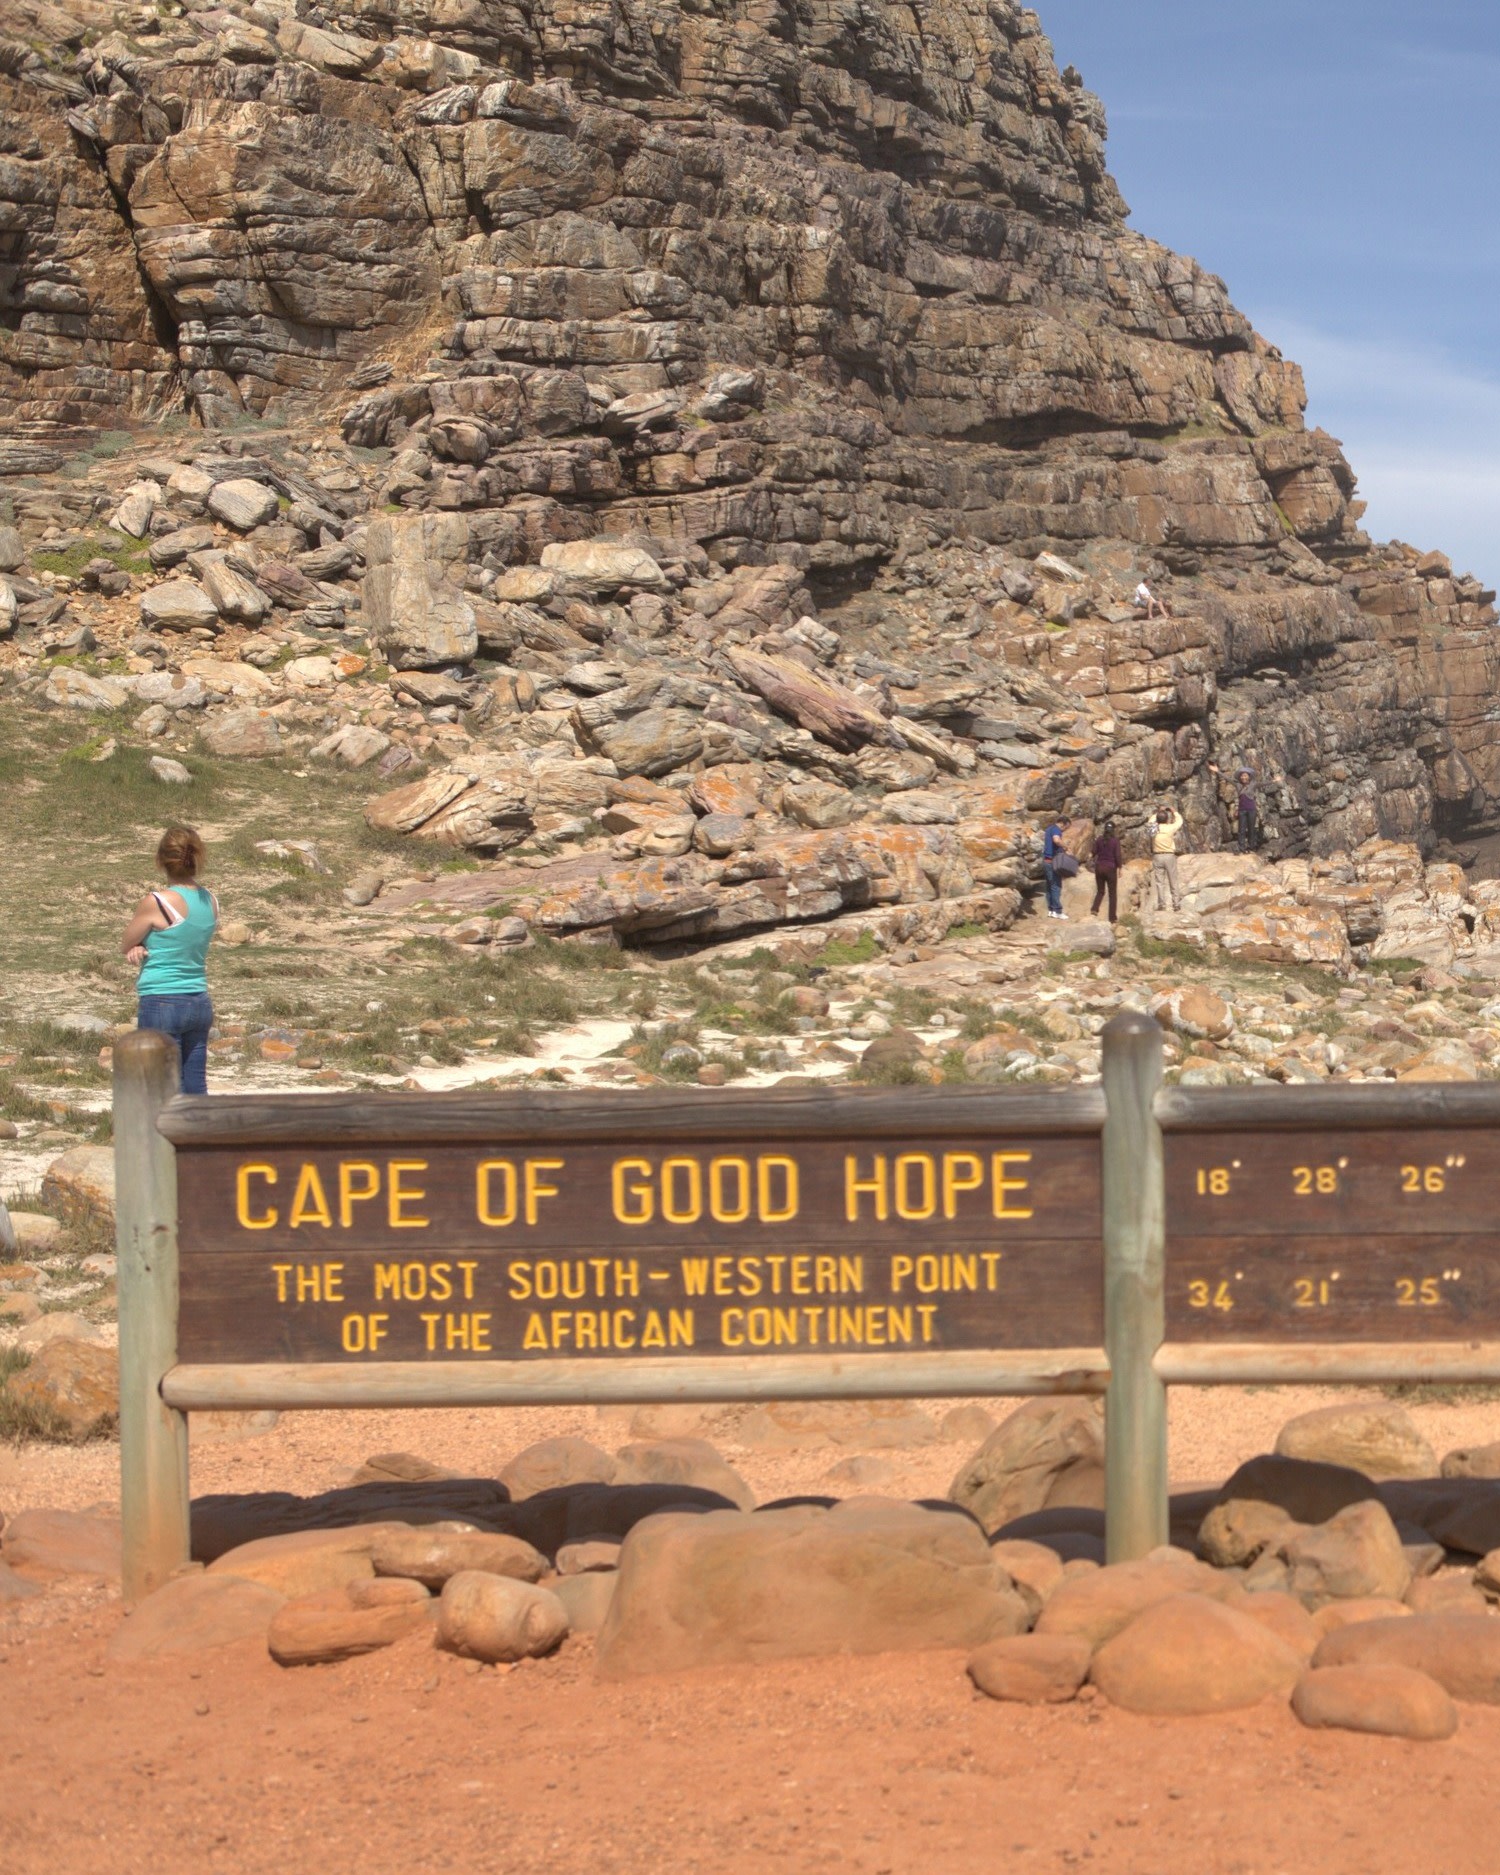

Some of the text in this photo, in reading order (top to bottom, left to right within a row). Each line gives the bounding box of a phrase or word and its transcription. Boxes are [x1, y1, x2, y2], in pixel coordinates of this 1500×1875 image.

[236, 1150, 1034, 1230] CAPE OF GOOD HOPE
[271, 1262, 344, 1302] THE
[374, 1260, 478, 1302] MOST
[891, 1251, 1002, 1293] POINT
[342, 1304, 937, 1353] OF THE AFRICAN CONTINENT
